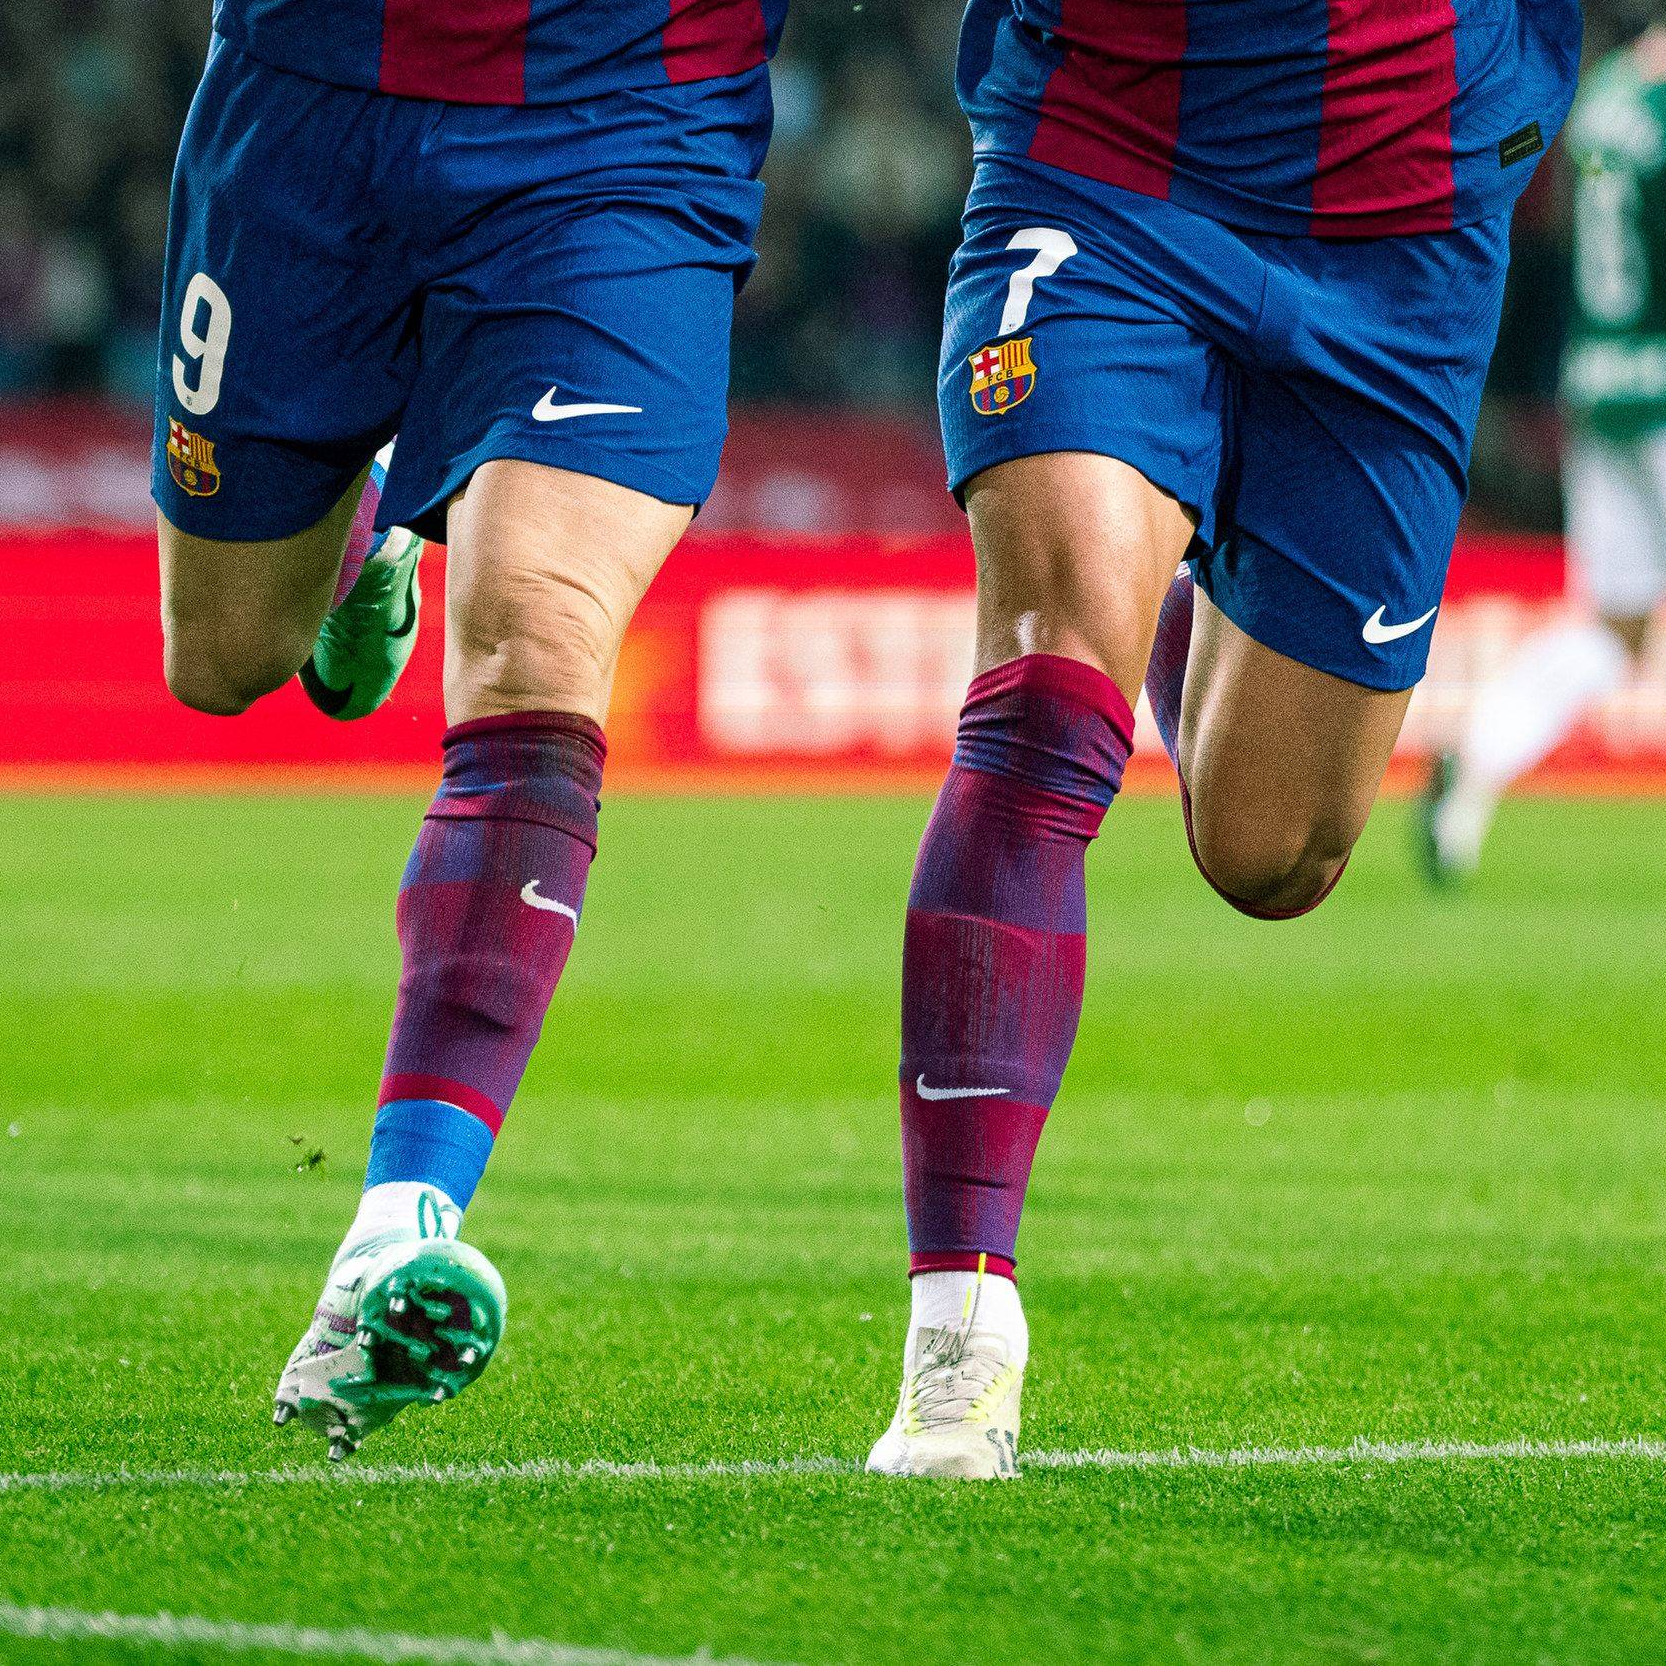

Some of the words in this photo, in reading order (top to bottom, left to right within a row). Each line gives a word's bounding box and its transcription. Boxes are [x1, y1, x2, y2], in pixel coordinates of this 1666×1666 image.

[998, 227, 1078, 336] 7
[172, 271, 231, 416] 9
[988, 370, 1013, 384] FCB
